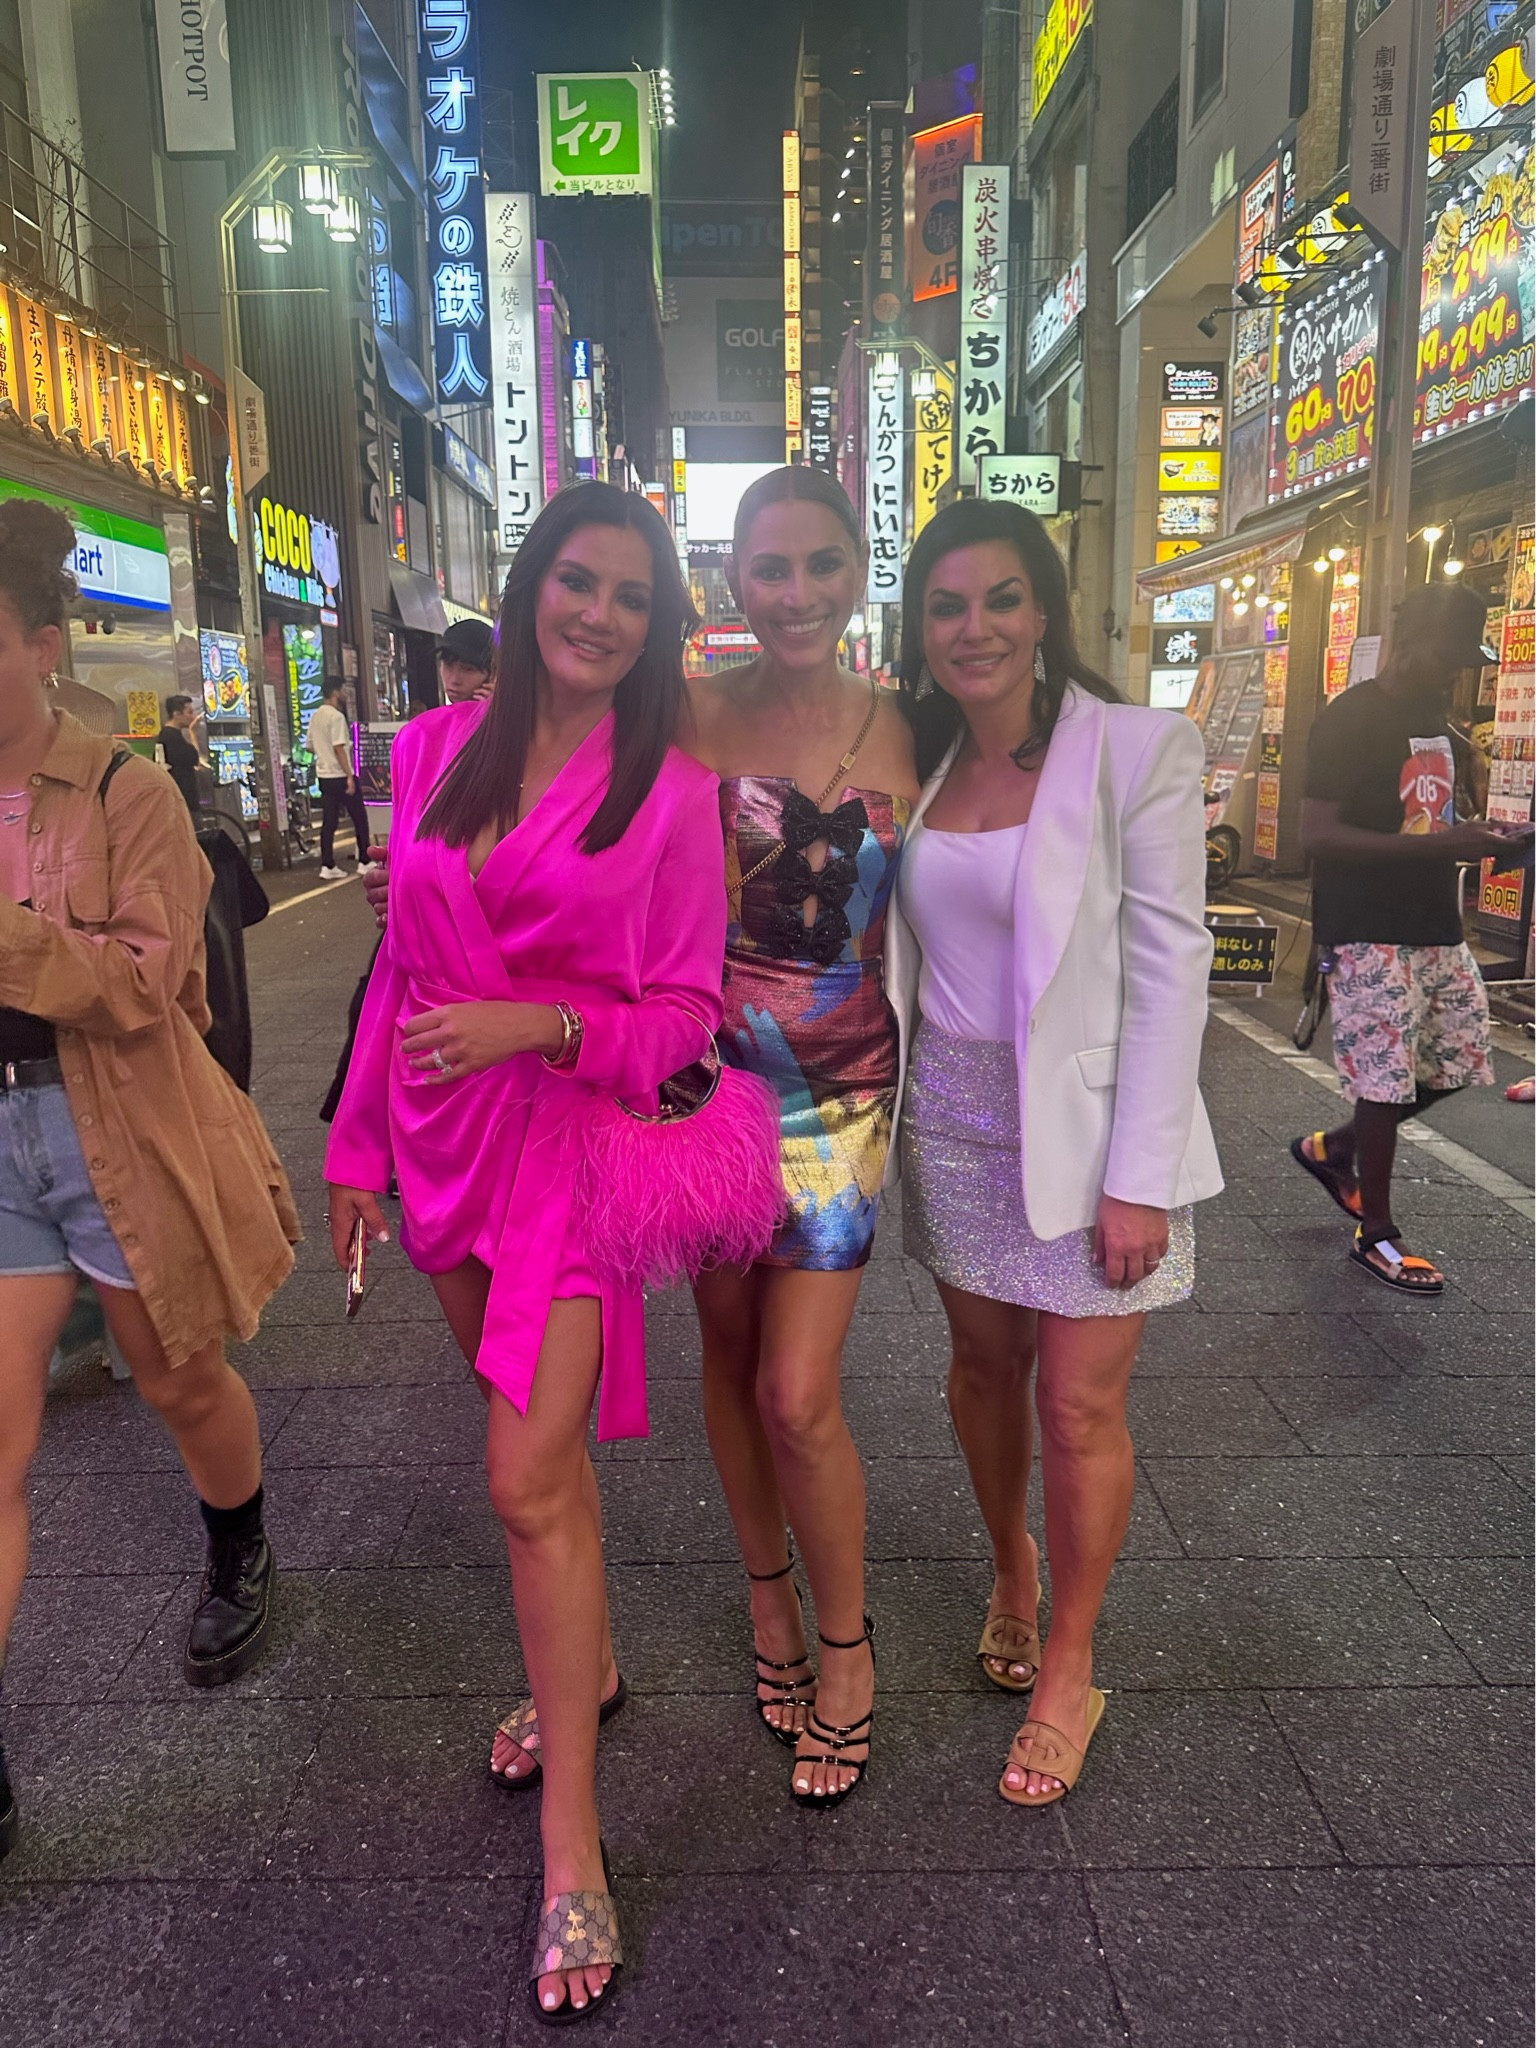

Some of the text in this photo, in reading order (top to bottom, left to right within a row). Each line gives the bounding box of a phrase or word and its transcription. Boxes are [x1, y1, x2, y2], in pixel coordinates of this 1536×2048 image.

[1369, 45, 1395, 194] 劇場通り一番街
[570, 179, 635, 191] 当ビルとなり
[880, 128, 893, 279] 個室ダイニング居酒屋
[1459, 195, 1501, 248] 生ビール
[929, 261, 957, 288] 4F
[1457, 277, 1498, 323] テキーラ
[505, 340, 522, 372] 酒場
[964, 331, 1001, 464] ちから
[506, 383, 530, 516] トントン
[988, 472, 1055, 495] ちから
[261, 497, 311, 574] COCO
[873, 482, 898, 588] にいむら
[1484, 884, 1519, 912] 60円
